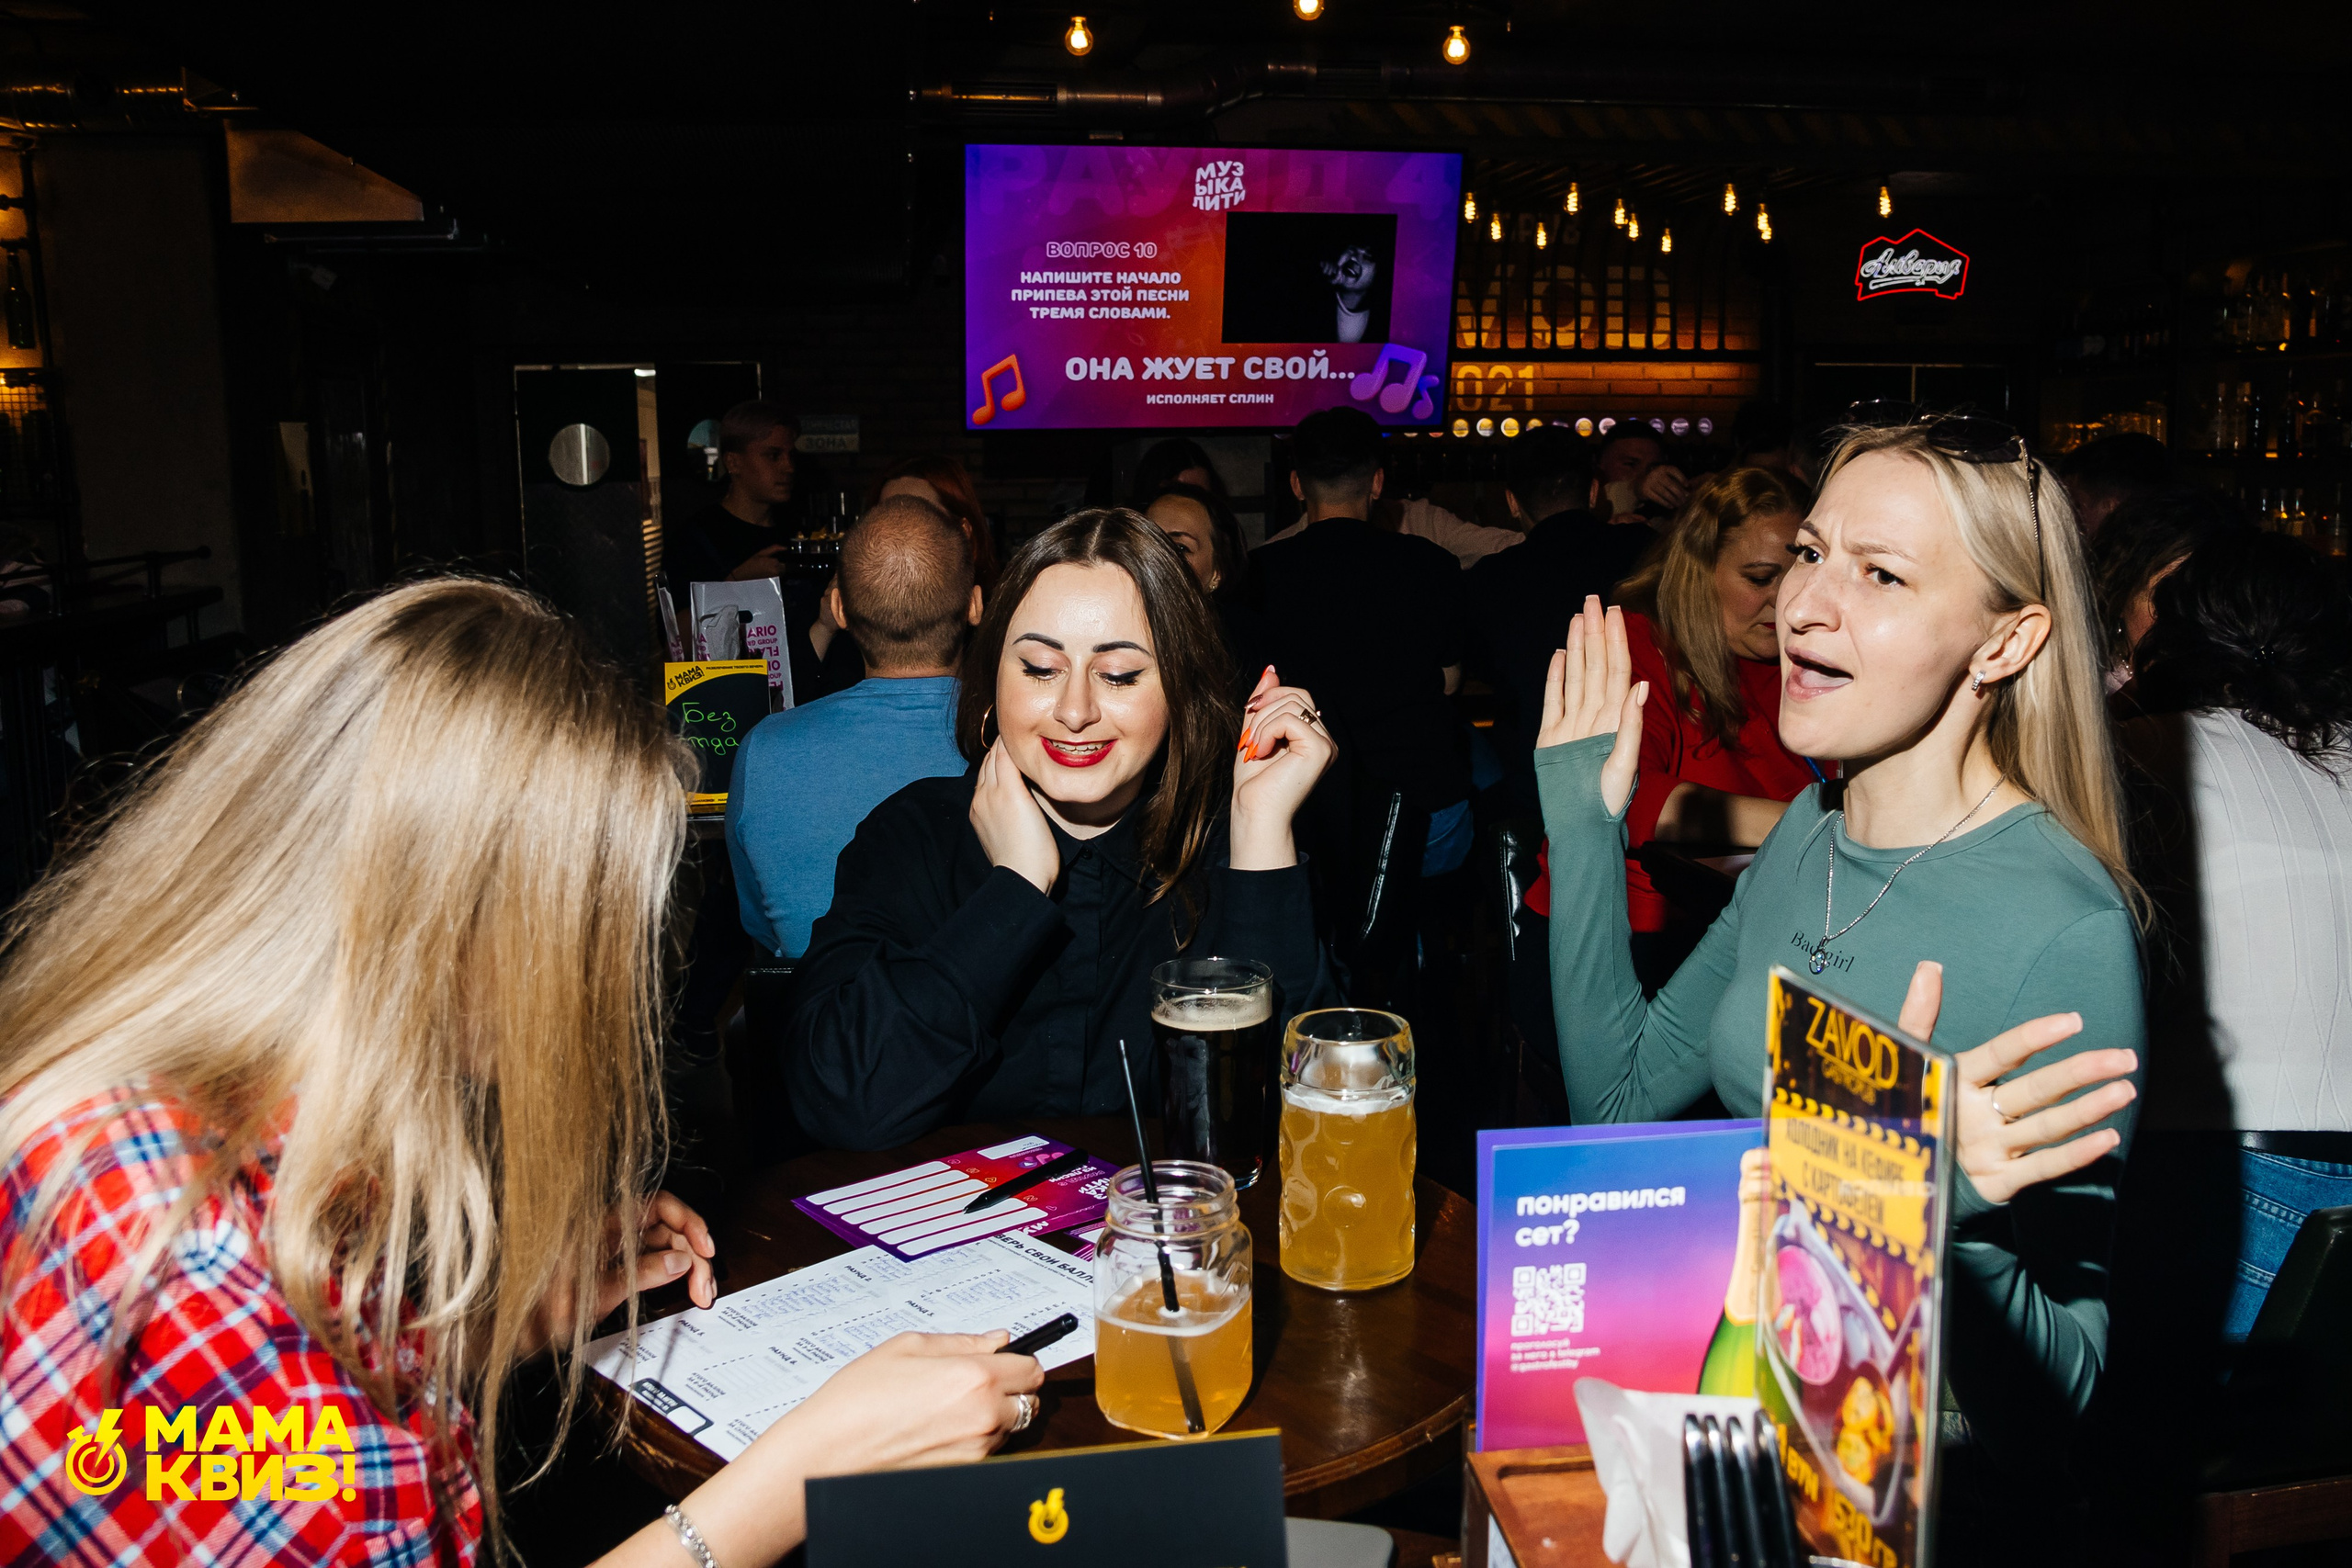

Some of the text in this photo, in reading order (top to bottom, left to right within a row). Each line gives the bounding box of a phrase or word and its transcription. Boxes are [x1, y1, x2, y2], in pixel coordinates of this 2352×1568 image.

[1195, 160, 1245, 183] МУЗ
[1194, 177, 1244, 196] ЫКА
[1193, 189, 1246, 211] ЛИТИ
[1046, 242, 1157, 258] ВОПРОС 10
[1021, 272, 1182, 284] НАПИШИТЕ НАЧАЛО
[1012, 286, 1190, 301] ПРИПЕВА ЭТОЙ ПЕСНИ
[1029, 308, 1171, 320] ТРЕМЯ СЛОВАМИ.
[1065, 349, 1356, 380] ОНА ЖУЕТ СВОЙ...
[1447, 365, 1533, 412] 021
[1147, 394, 1274, 404] ИСПОЛНЯЕТ СПЛИН
[674, 665, 702, 680] МАМА
[677, 671, 706, 688] КВИЗ!
[682, 702, 737, 733] Без
[679, 736, 740, 756] тда
[1805, 996, 1899, 1090] ZAVOD
[1516, 1186, 1686, 1219] понравился
[1515, 1218, 1580, 1247] сет?
[1024, 1248, 1060, 1265] СВОИ
[844, 1265, 866, 1279] РАУНД
[905, 1300, 928, 1314] РАУНД
[768, 1346, 791, 1361] РАУНД
